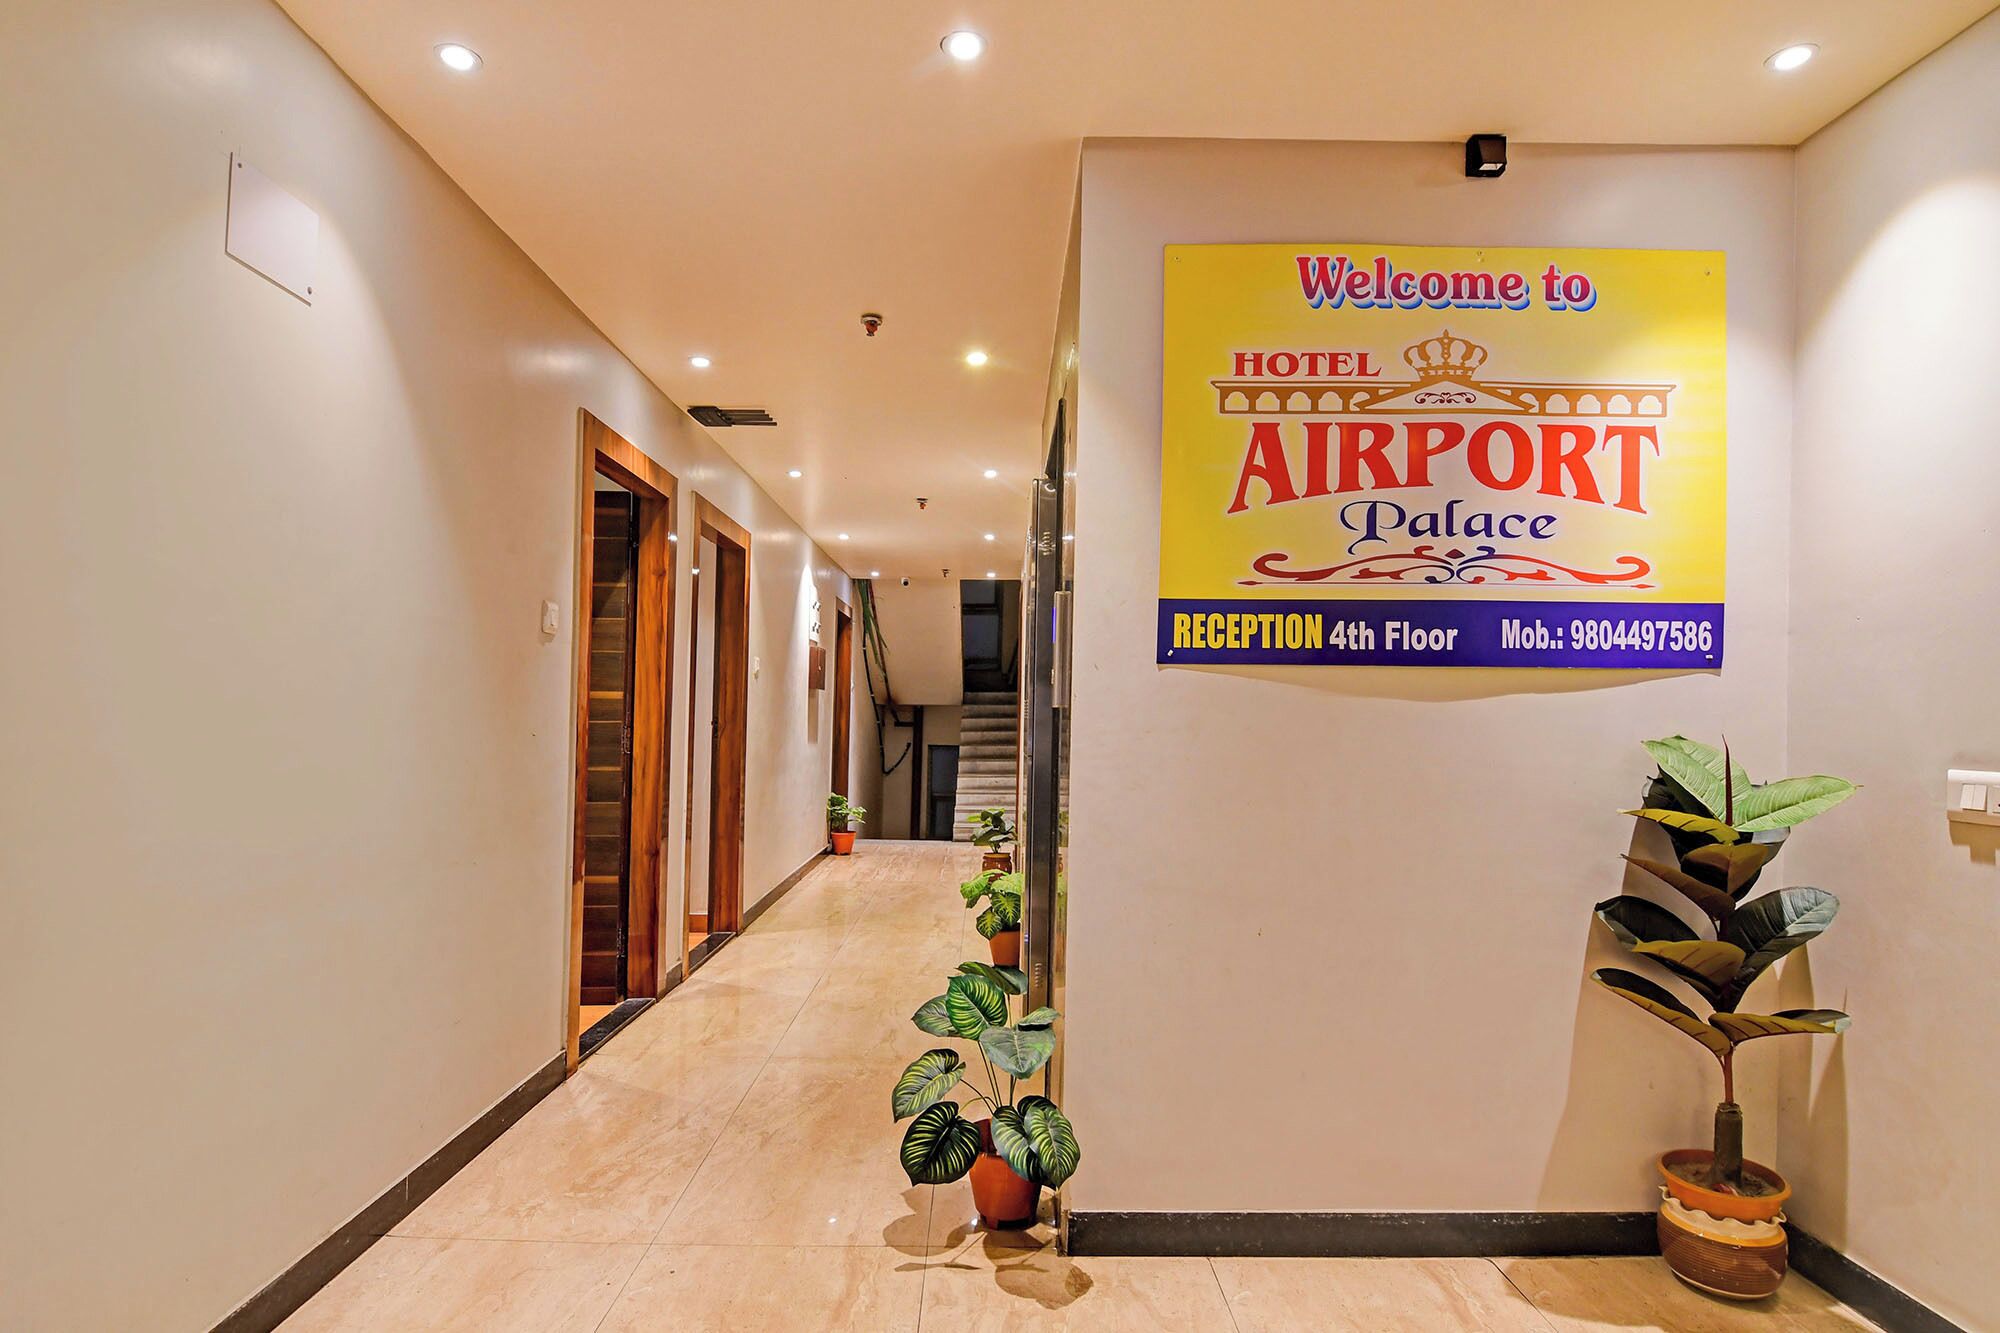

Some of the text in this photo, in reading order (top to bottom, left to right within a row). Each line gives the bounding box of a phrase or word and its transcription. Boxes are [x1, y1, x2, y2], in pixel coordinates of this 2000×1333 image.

[1296, 256, 1597, 312] Welcome to
[1233, 352, 1381, 377] HOTEL
[1227, 421, 1661, 515] AIRPORT
[1339, 499, 1557, 555] Palace
[1173, 613, 1458, 650] RECEPTION 4th Floor
[1501, 619, 1713, 652] Mob.: 9804497586
